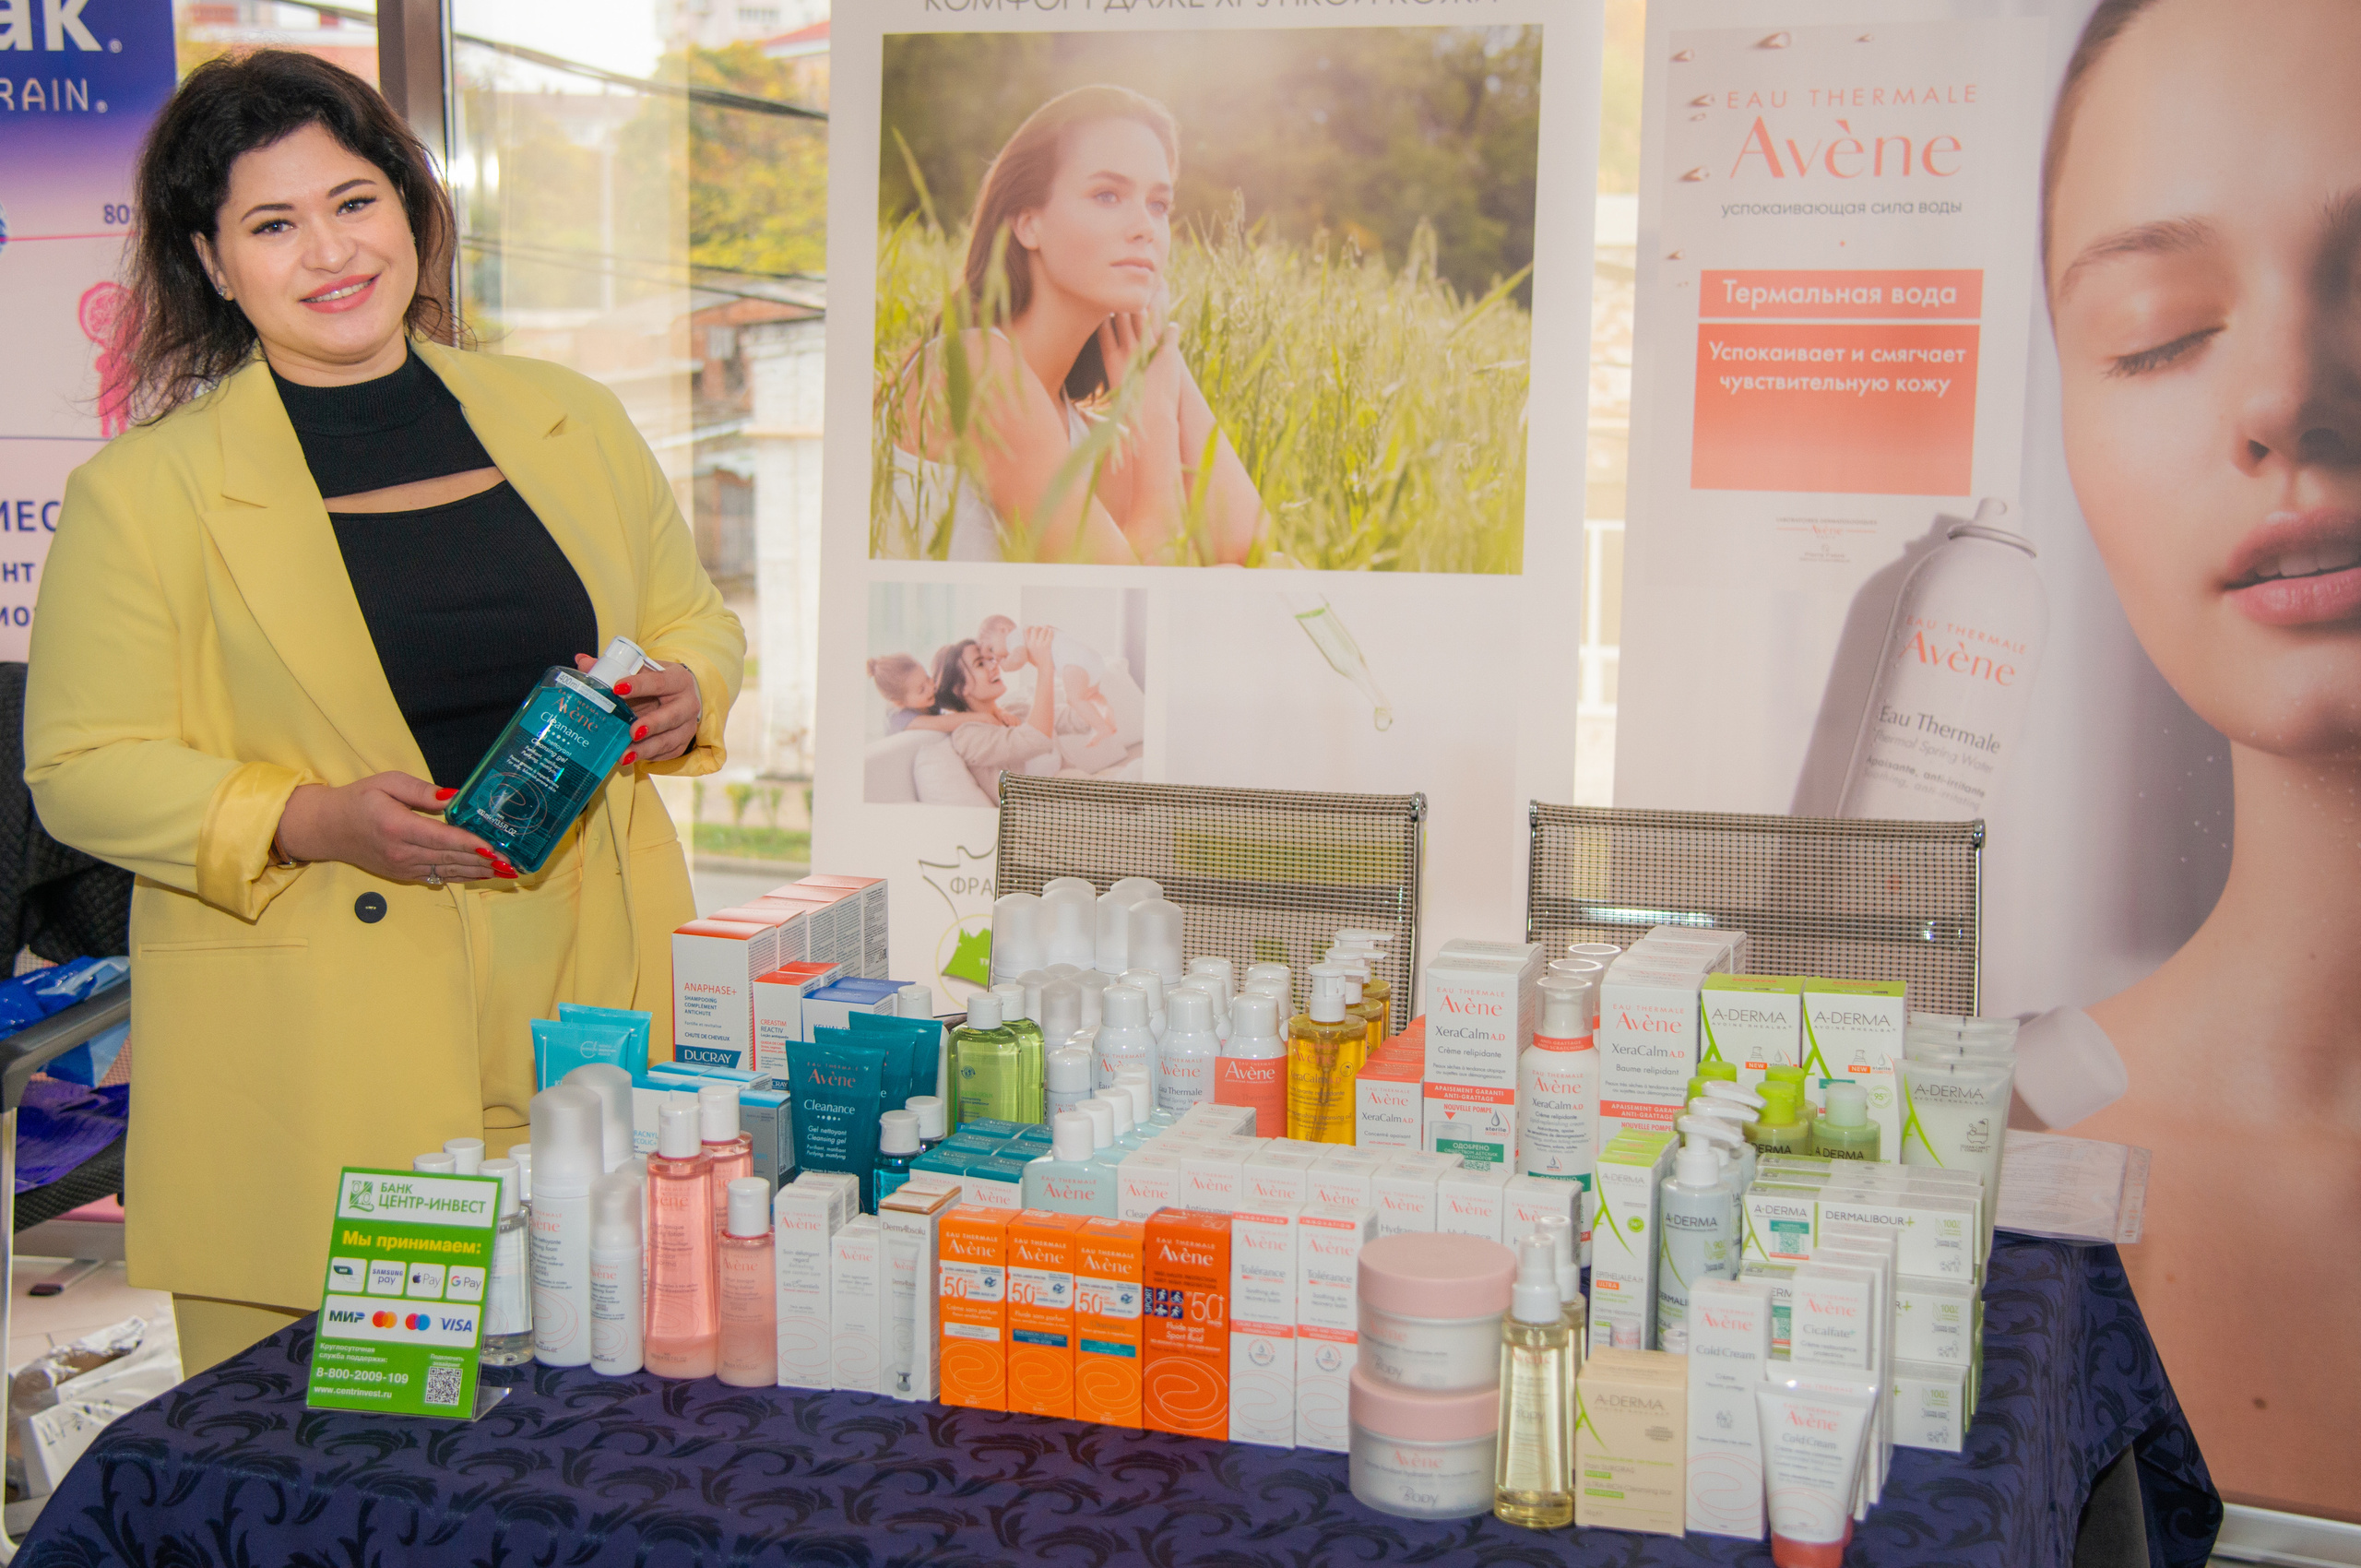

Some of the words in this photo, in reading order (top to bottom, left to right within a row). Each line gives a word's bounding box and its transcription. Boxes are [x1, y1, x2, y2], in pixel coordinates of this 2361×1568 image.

[1727, 91, 1787, 110] EAU
[1809, 85, 1977, 107] THERMALE
[1729, 115, 1963, 179] Avène
[1721, 202, 1866, 219] успокаивающая
[1870, 201, 1914, 214] сила
[1918, 201, 1963, 215] воды
[1722, 279, 1881, 310] Термальная
[1891, 286, 1957, 307] вода
[1709, 341, 1845, 362] Успокаивает
[1852, 349, 1865, 362] и
[1870, 349, 1965, 362] смягчает
[1719, 375, 1890, 397] чувствительную
[1895, 376, 1952, 398] кожу
[1906, 615, 1936, 630] EAU
[1948, 624, 2026, 655] THERMALE
[1898, 631, 2015, 686] Avène
[540, 711, 589, 747] Cleanance
[1880, 706, 1910, 728] Eau
[1916, 713, 2000, 754] Thermale
[1919, 740, 1957, 765] Spring
[684, 982, 737, 995] ANAPHASE+
[1436, 986, 1454, 994] EAU
[1458, 989, 1505, 998] THERMALE
[684, 995, 717, 1004] SHAMPOOING
[1439, 994, 1502, 1017] Avène
[1636, 1005, 1684, 1015] THERMALE
[1711, 1008, 1787, 1025] A-DERMA
[761, 1018, 787, 1027] CREASTIM
[1616, 1012, 1682, 1034] Avène
[1814, 1010, 1891, 1027] A-DERMA
[1435, 1026, 1489, 1040] XeraCalm
[1490, 1033, 1505, 1041] A.D
[685, 1049, 732, 1064] DUCRAY
[1438, 1045, 1461, 1055] Crème
[1463, 1048, 1501, 1059] relipidante
[1611, 1043, 1668, 1057] XeraCalm
[1669, 1051, 1685, 1059] A.D
[1159, 1061, 1201, 1077] Avène
[1225, 1061, 1275, 1080] Avène
[1468, 1072, 1502, 1080] démangeaisons
[1616, 1063, 1641, 1073] Baume
[1643, 1066, 1679, 1075] relipidant
[808, 1069, 856, 1087] Avène
[1534, 1076, 1582, 1094] Avène
[1169, 1087, 1203, 1096] Thermale
[1435, 1086, 1473, 1094] APAISEMENT
[1444, 1093, 1494, 1102] ANTI-GRATTAGE
[1914, 1084, 1984, 1099] A-DERMA
[803, 1099, 856, 1114] Cleanance
[1367, 1092, 1408, 1107] Avène
[1443, 1103, 1471, 1111] NOUVELLE
[1532, 1098, 1572, 1110] XeraCalm
[1611, 1103, 1651, 1111] APAISEMENT
[1361, 1111, 1402, 1123] XeraCalm
[1621, 1111, 1673, 1120] ANTI-GRATTAGE
[821, 1127, 847, 1135] nettoyant
[1621, 1122, 1650, 1130] NOUVELLE
[807, 1134, 835, 1144] Cleansing
[1390, 1132, 1411, 1140] apaisant
[1453, 1143, 1489, 1151] ОДОБРЕНО
[1190, 1176, 1232, 1193] Avène
[1602, 1172, 1644, 1183] A-DERMA
[381, 1182, 413, 1194] БАНК
[1043, 1182, 1096, 1201] Avène
[1125, 1183, 1169, 1200] Avène
[1252, 1182, 1296, 1199] Avène
[378, 1194, 486, 1215] ЦЕНТР-ИНВЕСТ
[975, 1189, 1011, 1205] Avène
[1316, 1189, 1359, 1206] Avène
[1380, 1195, 1424, 1213] Avène
[1447, 1199, 1492, 1218] Avène
[780, 1217, 821, 1231] Avène
[1236, 1214, 1285, 1224] INNOVATION
[1301, 1219, 1351, 1229] INNOVATION
[1825, 1210, 1915, 1227] DERMALIBOUR+
[342, 1230, 372, 1246] Мы
[376, 1236, 481, 1254] принимаем:
[963, 1233, 998, 1242] THERMALE
[1031, 1240, 1066, 1249] THERMALE
[1176, 1239, 1216, 1250] THERMALE
[1240, 1234, 1287, 1252] Avène
[949, 1238, 995, 1257] Avène
[1016, 1245, 1064, 1265] Avène
[1098, 1249, 1134, 1259] THERMALE
[1158, 1244, 1214, 1266] Avène
[1307, 1239, 1354, 1256] Avène
[1084, 1254, 1132, 1275] Avène
[1240, 1265, 1286, 1278] Tolérance
[373, 1268, 404, 1277] SAMSUNG
[1307, 1269, 1352, 1283] Tolérance
[377, 1276, 396, 1285] pay
[422, 1273, 442, 1288] Pay
[464, 1277, 481, 1290] Pay
[1145, 1288, 1153, 1313] SPORT
[1804, 1298, 1857, 1317] Avène
[329, 1310, 365, 1323] МИР
[1700, 1312, 1753, 1332] Avène
[440, 1317, 472, 1332] VISA
[1166, 1322, 1186, 1331] Fluide
[1167, 1331, 1186, 1340] Sport
[320, 1342, 375, 1353] Круглосуточная
[1695, 1344, 1721, 1357] Cold
[1723, 1347, 1755, 1361] Cream
[346, 1354, 387, 1363] поддержки:
[316, 1367, 409, 1384] 8-800-2009-109
[314, 1385, 392, 1398] www.centrinvest.ru
[1594, 1394, 1664, 1410] A-DERMA
[1786, 1410, 1838, 1431] Avène
[1782, 1432, 1805, 1443] Cold
[1806, 1437, 1837, 1449] Cream
